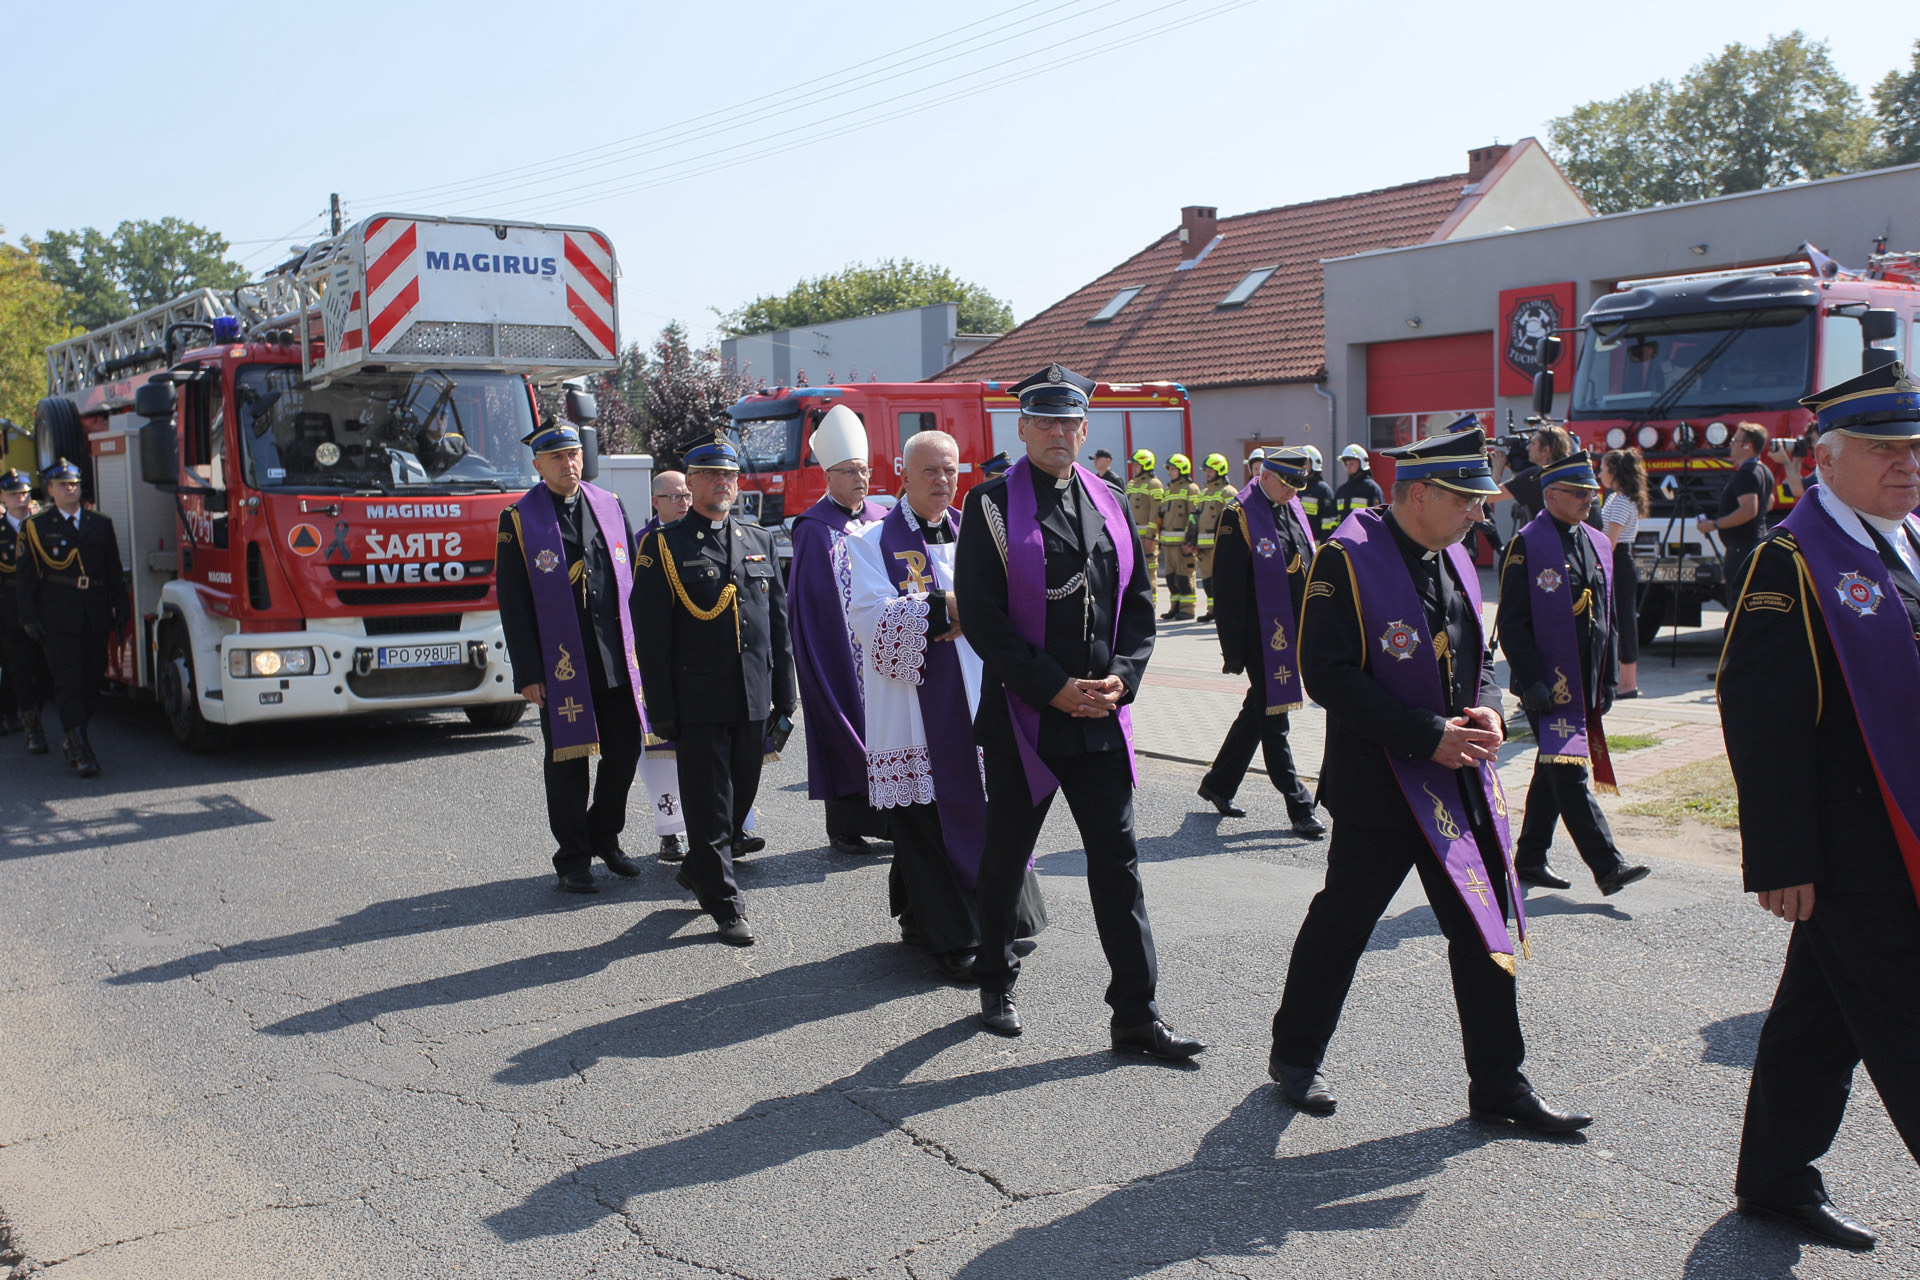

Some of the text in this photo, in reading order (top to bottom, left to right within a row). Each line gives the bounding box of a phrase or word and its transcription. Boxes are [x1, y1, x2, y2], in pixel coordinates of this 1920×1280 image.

[426, 251, 557, 276] MAGIRUS
[366, 504, 461, 519] MAGIRUS
[208, 571, 232, 583] MAGIRUS
[366, 561, 465, 585] IVECO
[388, 649, 410, 664] PO
[415, 646, 458, 663] 998UF
